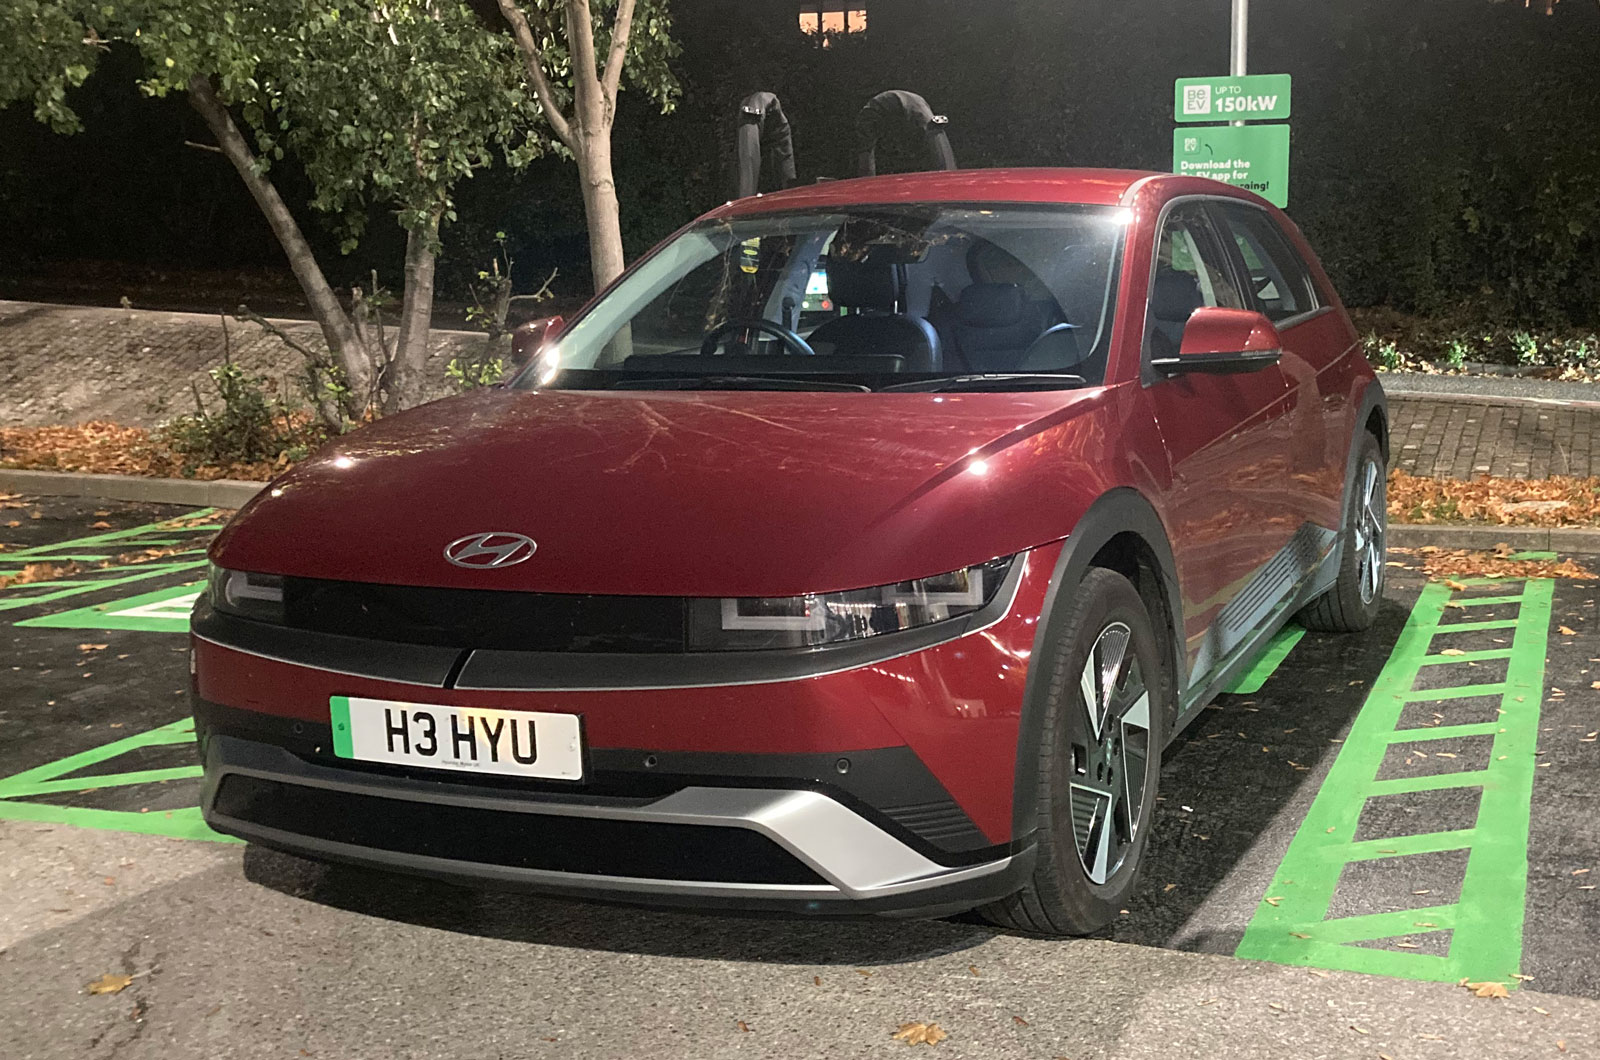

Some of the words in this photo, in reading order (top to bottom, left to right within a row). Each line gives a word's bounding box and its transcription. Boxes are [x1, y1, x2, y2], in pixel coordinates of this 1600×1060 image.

[1187, 88, 1206, 100] Be
[1215, 86, 1227, 94] UP
[1229, 86, 1242, 94] TO
[1187, 100, 1206, 111] EV
[1215, 95, 1278, 112] 150kW
[1180, 159, 1231, 170] Download
[1233, 158, 1251, 168] the
[1212, 172, 1231, 182] app
[1232, 170, 1248, 179] for
[384, 708, 438, 757] H3
[450, 714, 538, 765] HYU
